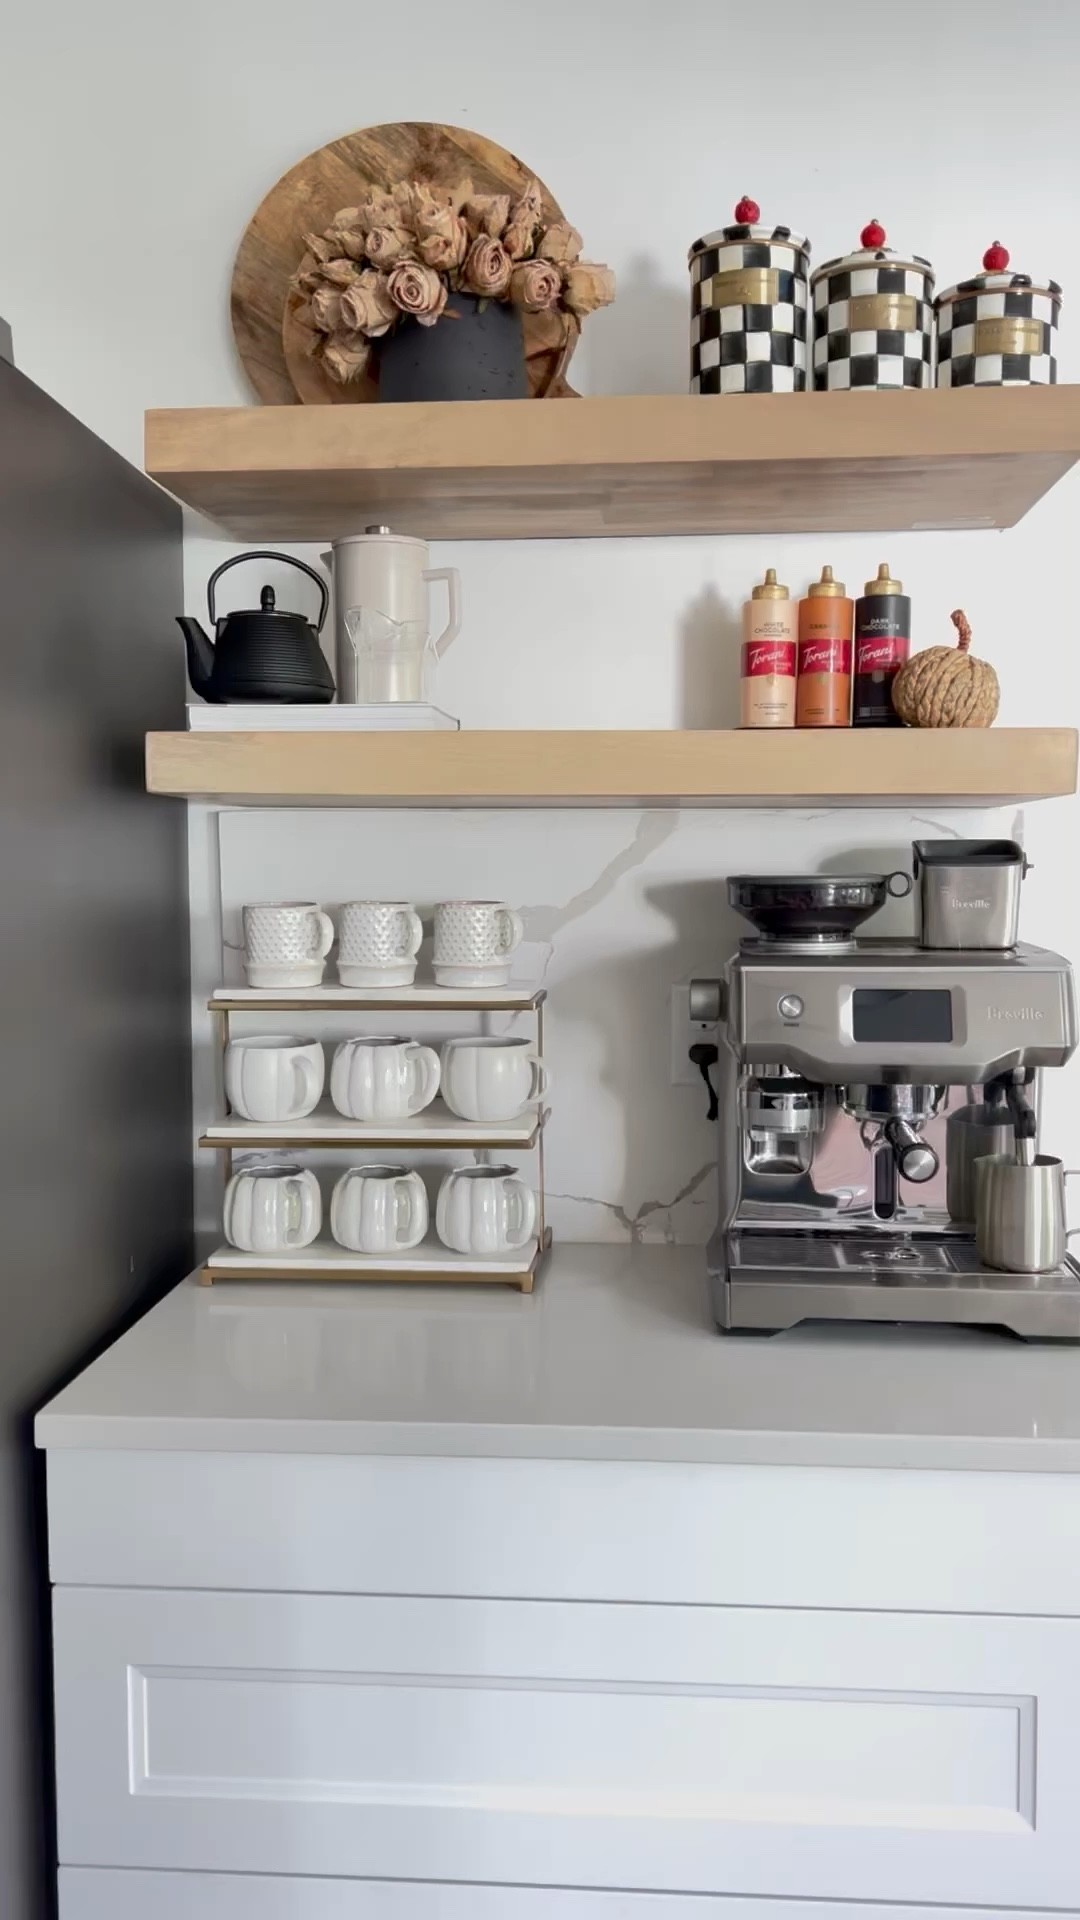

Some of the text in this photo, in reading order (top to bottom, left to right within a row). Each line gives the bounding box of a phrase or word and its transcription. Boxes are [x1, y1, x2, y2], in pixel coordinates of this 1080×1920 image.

[750, 647, 786, 670] Torani
[803, 645, 838, 668] Torani
[858, 644, 894, 669] Torani
[951, 899, 991, 909] Breville
[987, 1006, 1045, 1021] Breville
